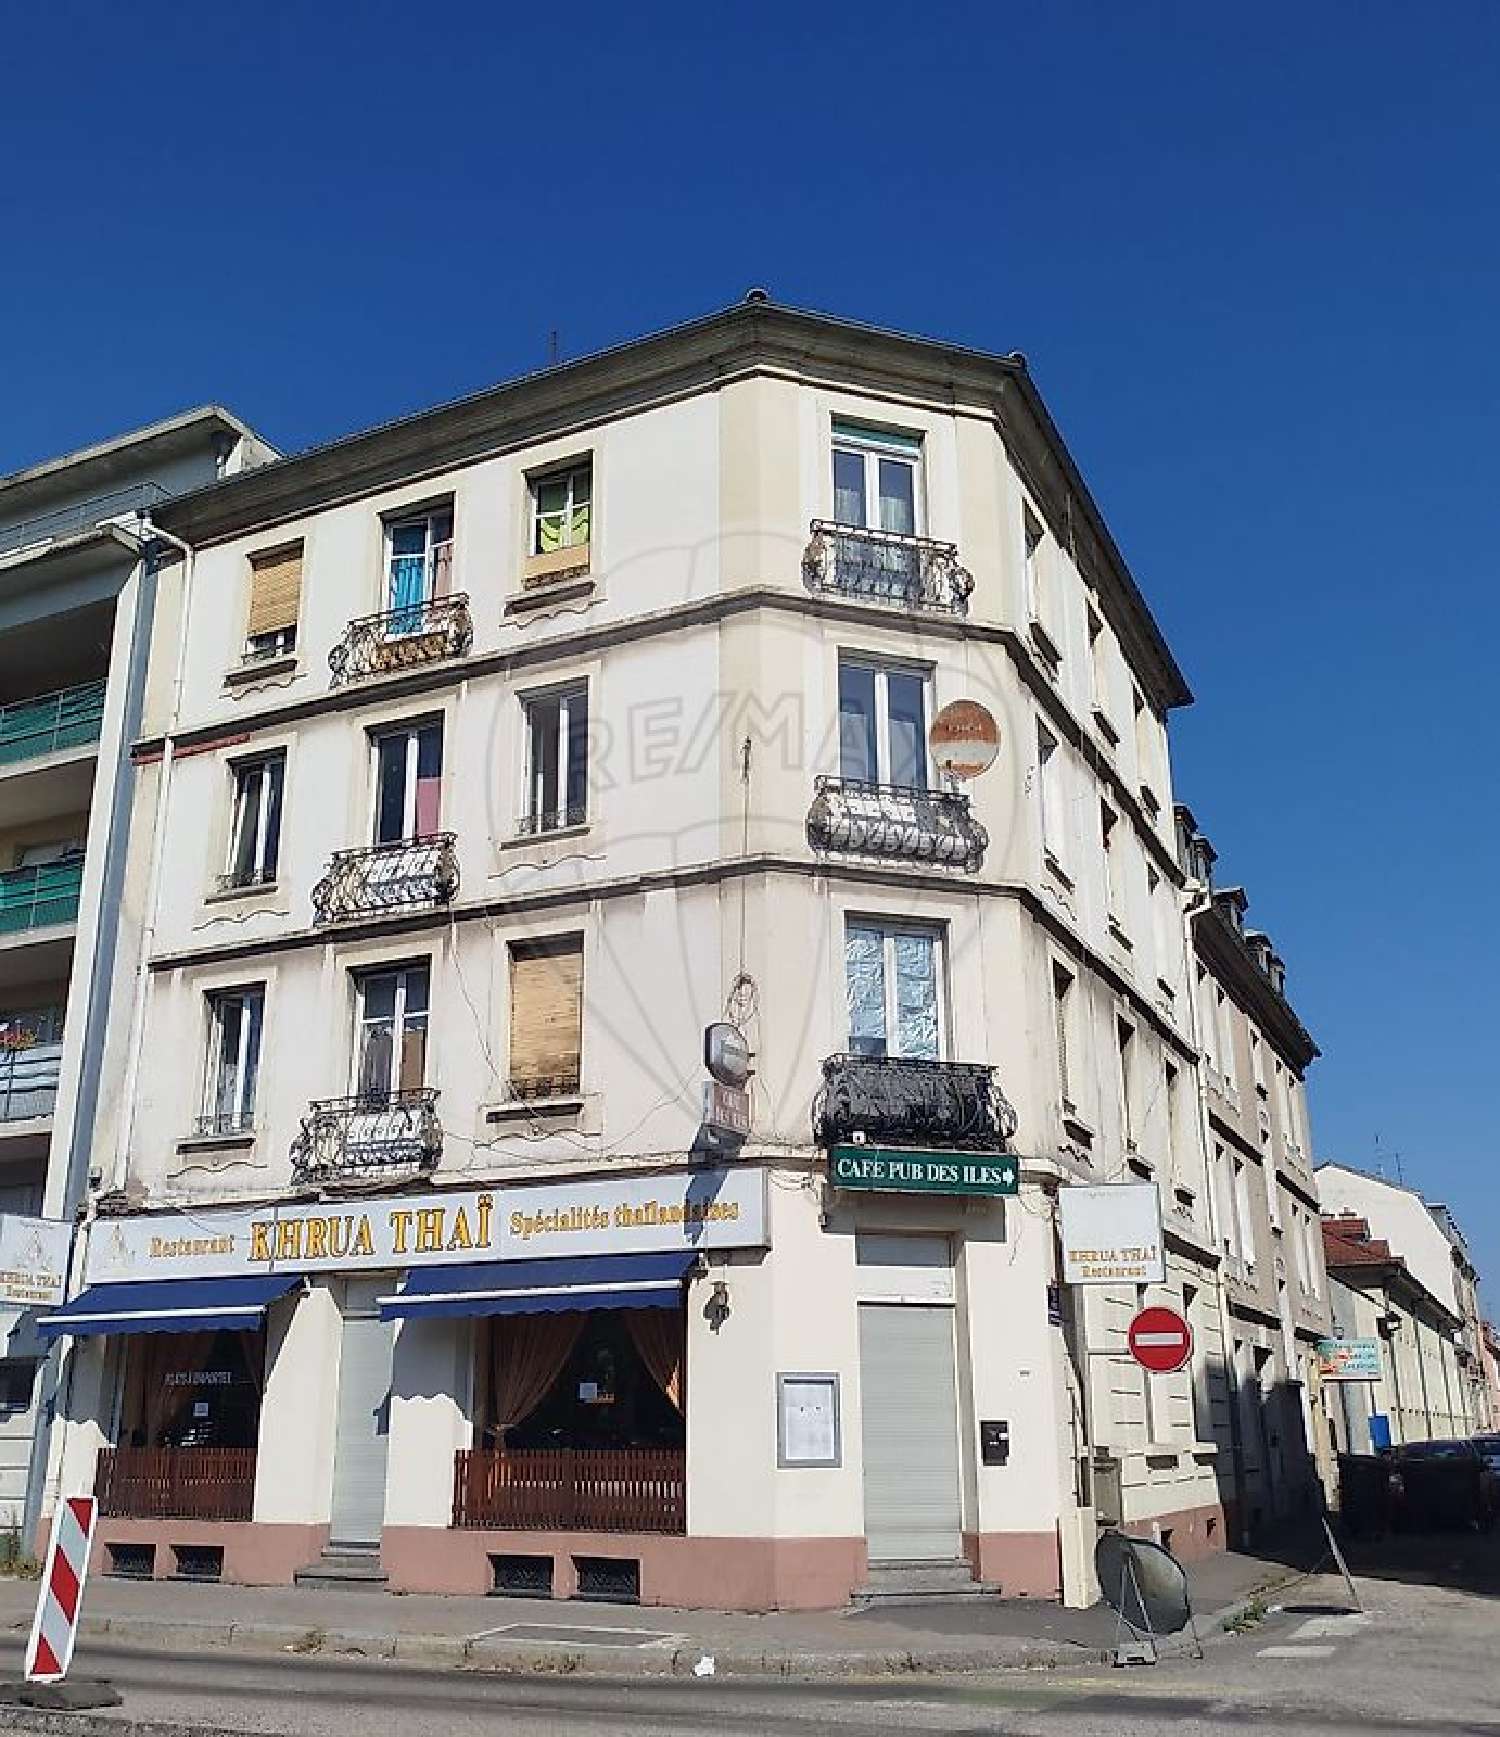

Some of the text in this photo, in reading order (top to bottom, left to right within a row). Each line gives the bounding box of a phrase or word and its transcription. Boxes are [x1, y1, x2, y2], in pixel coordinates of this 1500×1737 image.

[888, 1161, 924, 1181] PUB
[926, 1163, 958, 1183] DES
[962, 1165, 1002, 1185] ILES
[247, 1214, 376, 1261] KHRUA
